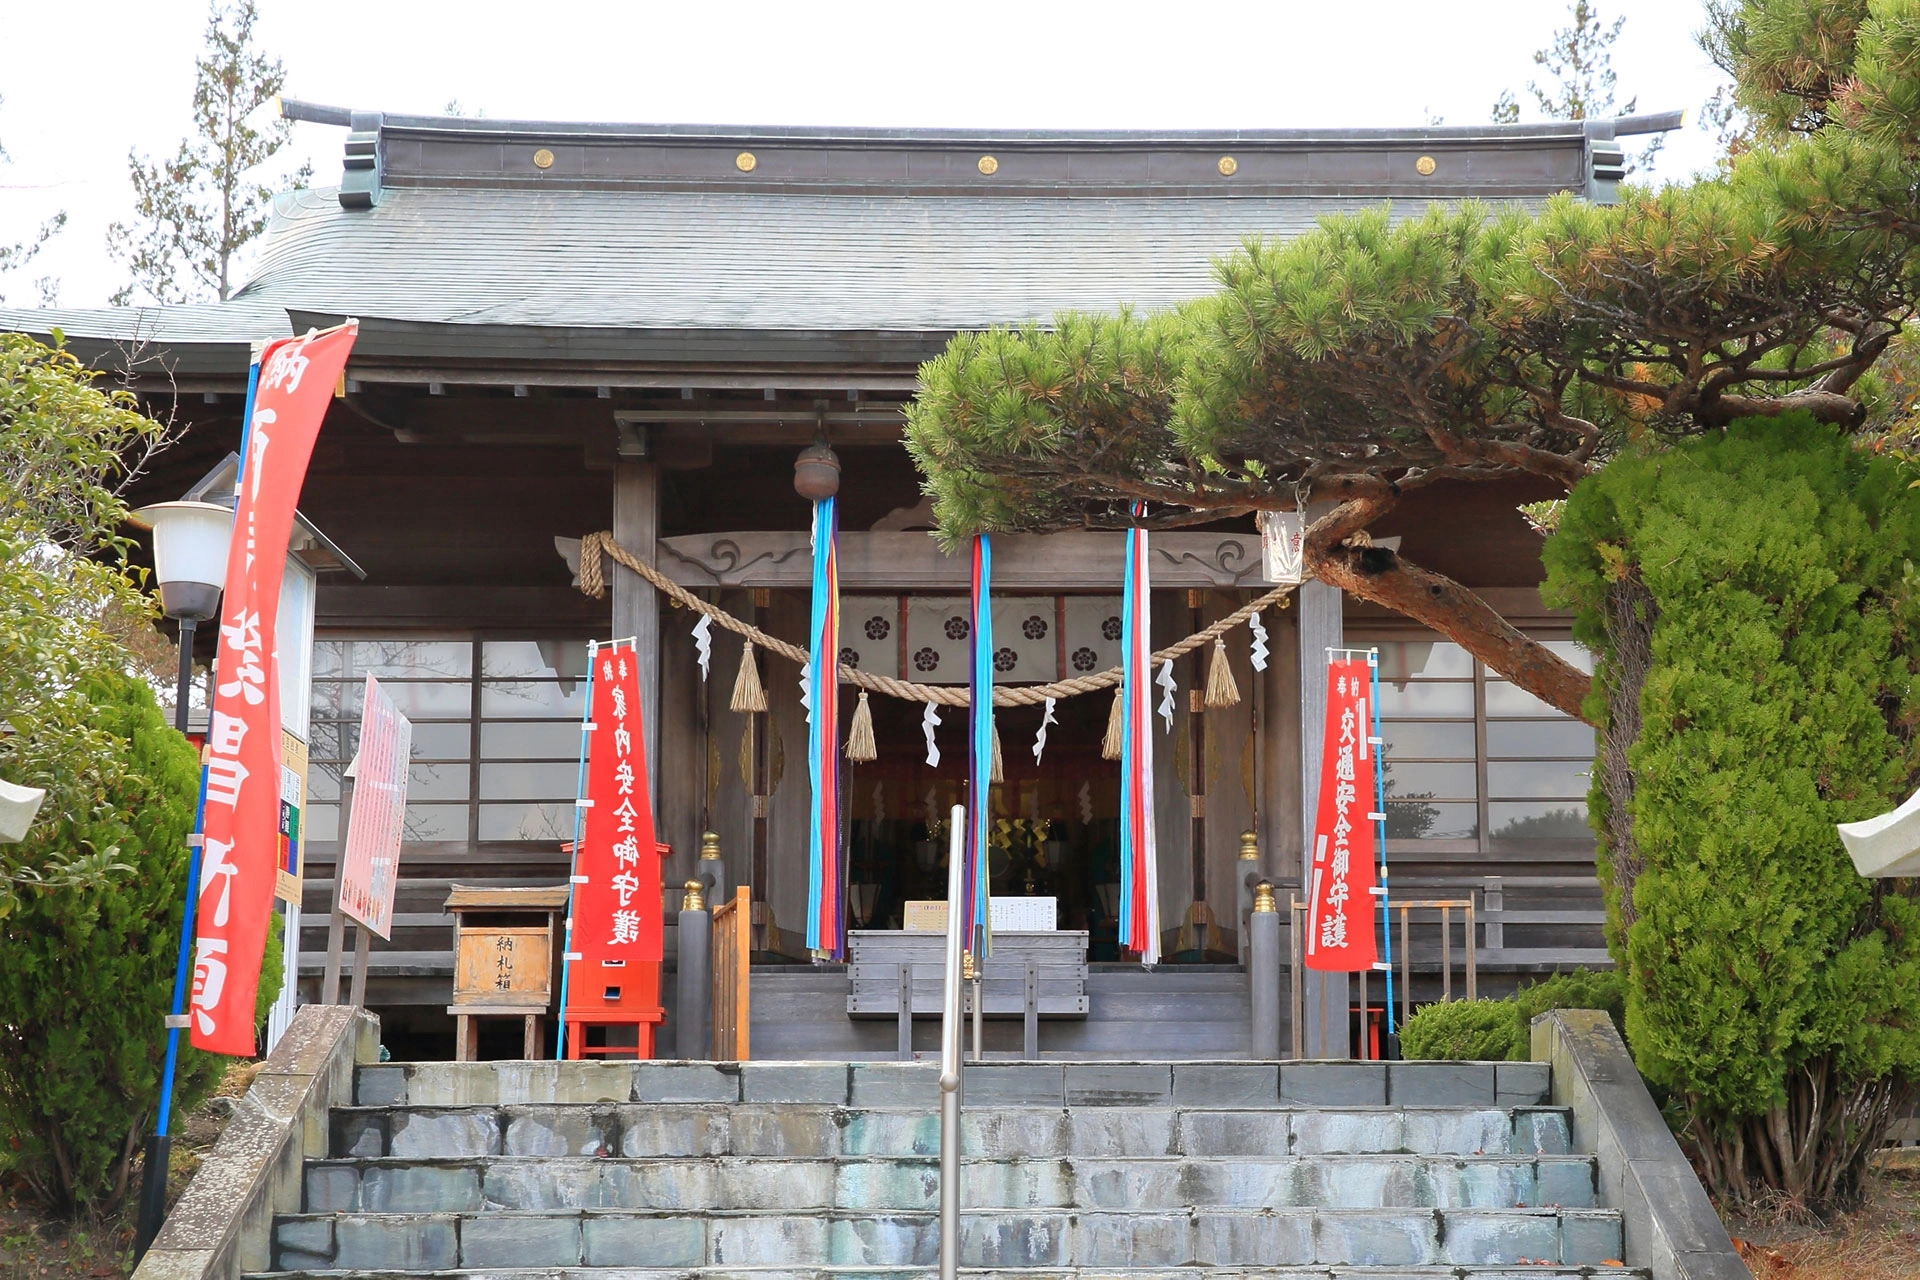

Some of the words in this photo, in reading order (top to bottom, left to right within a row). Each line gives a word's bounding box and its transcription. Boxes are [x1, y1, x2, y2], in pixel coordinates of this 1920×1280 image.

[1337, 676, 1360, 698] 奉納
[1321, 707, 1356, 948] 交通安全御守護
[495, 936, 513, 990] 納札箱
